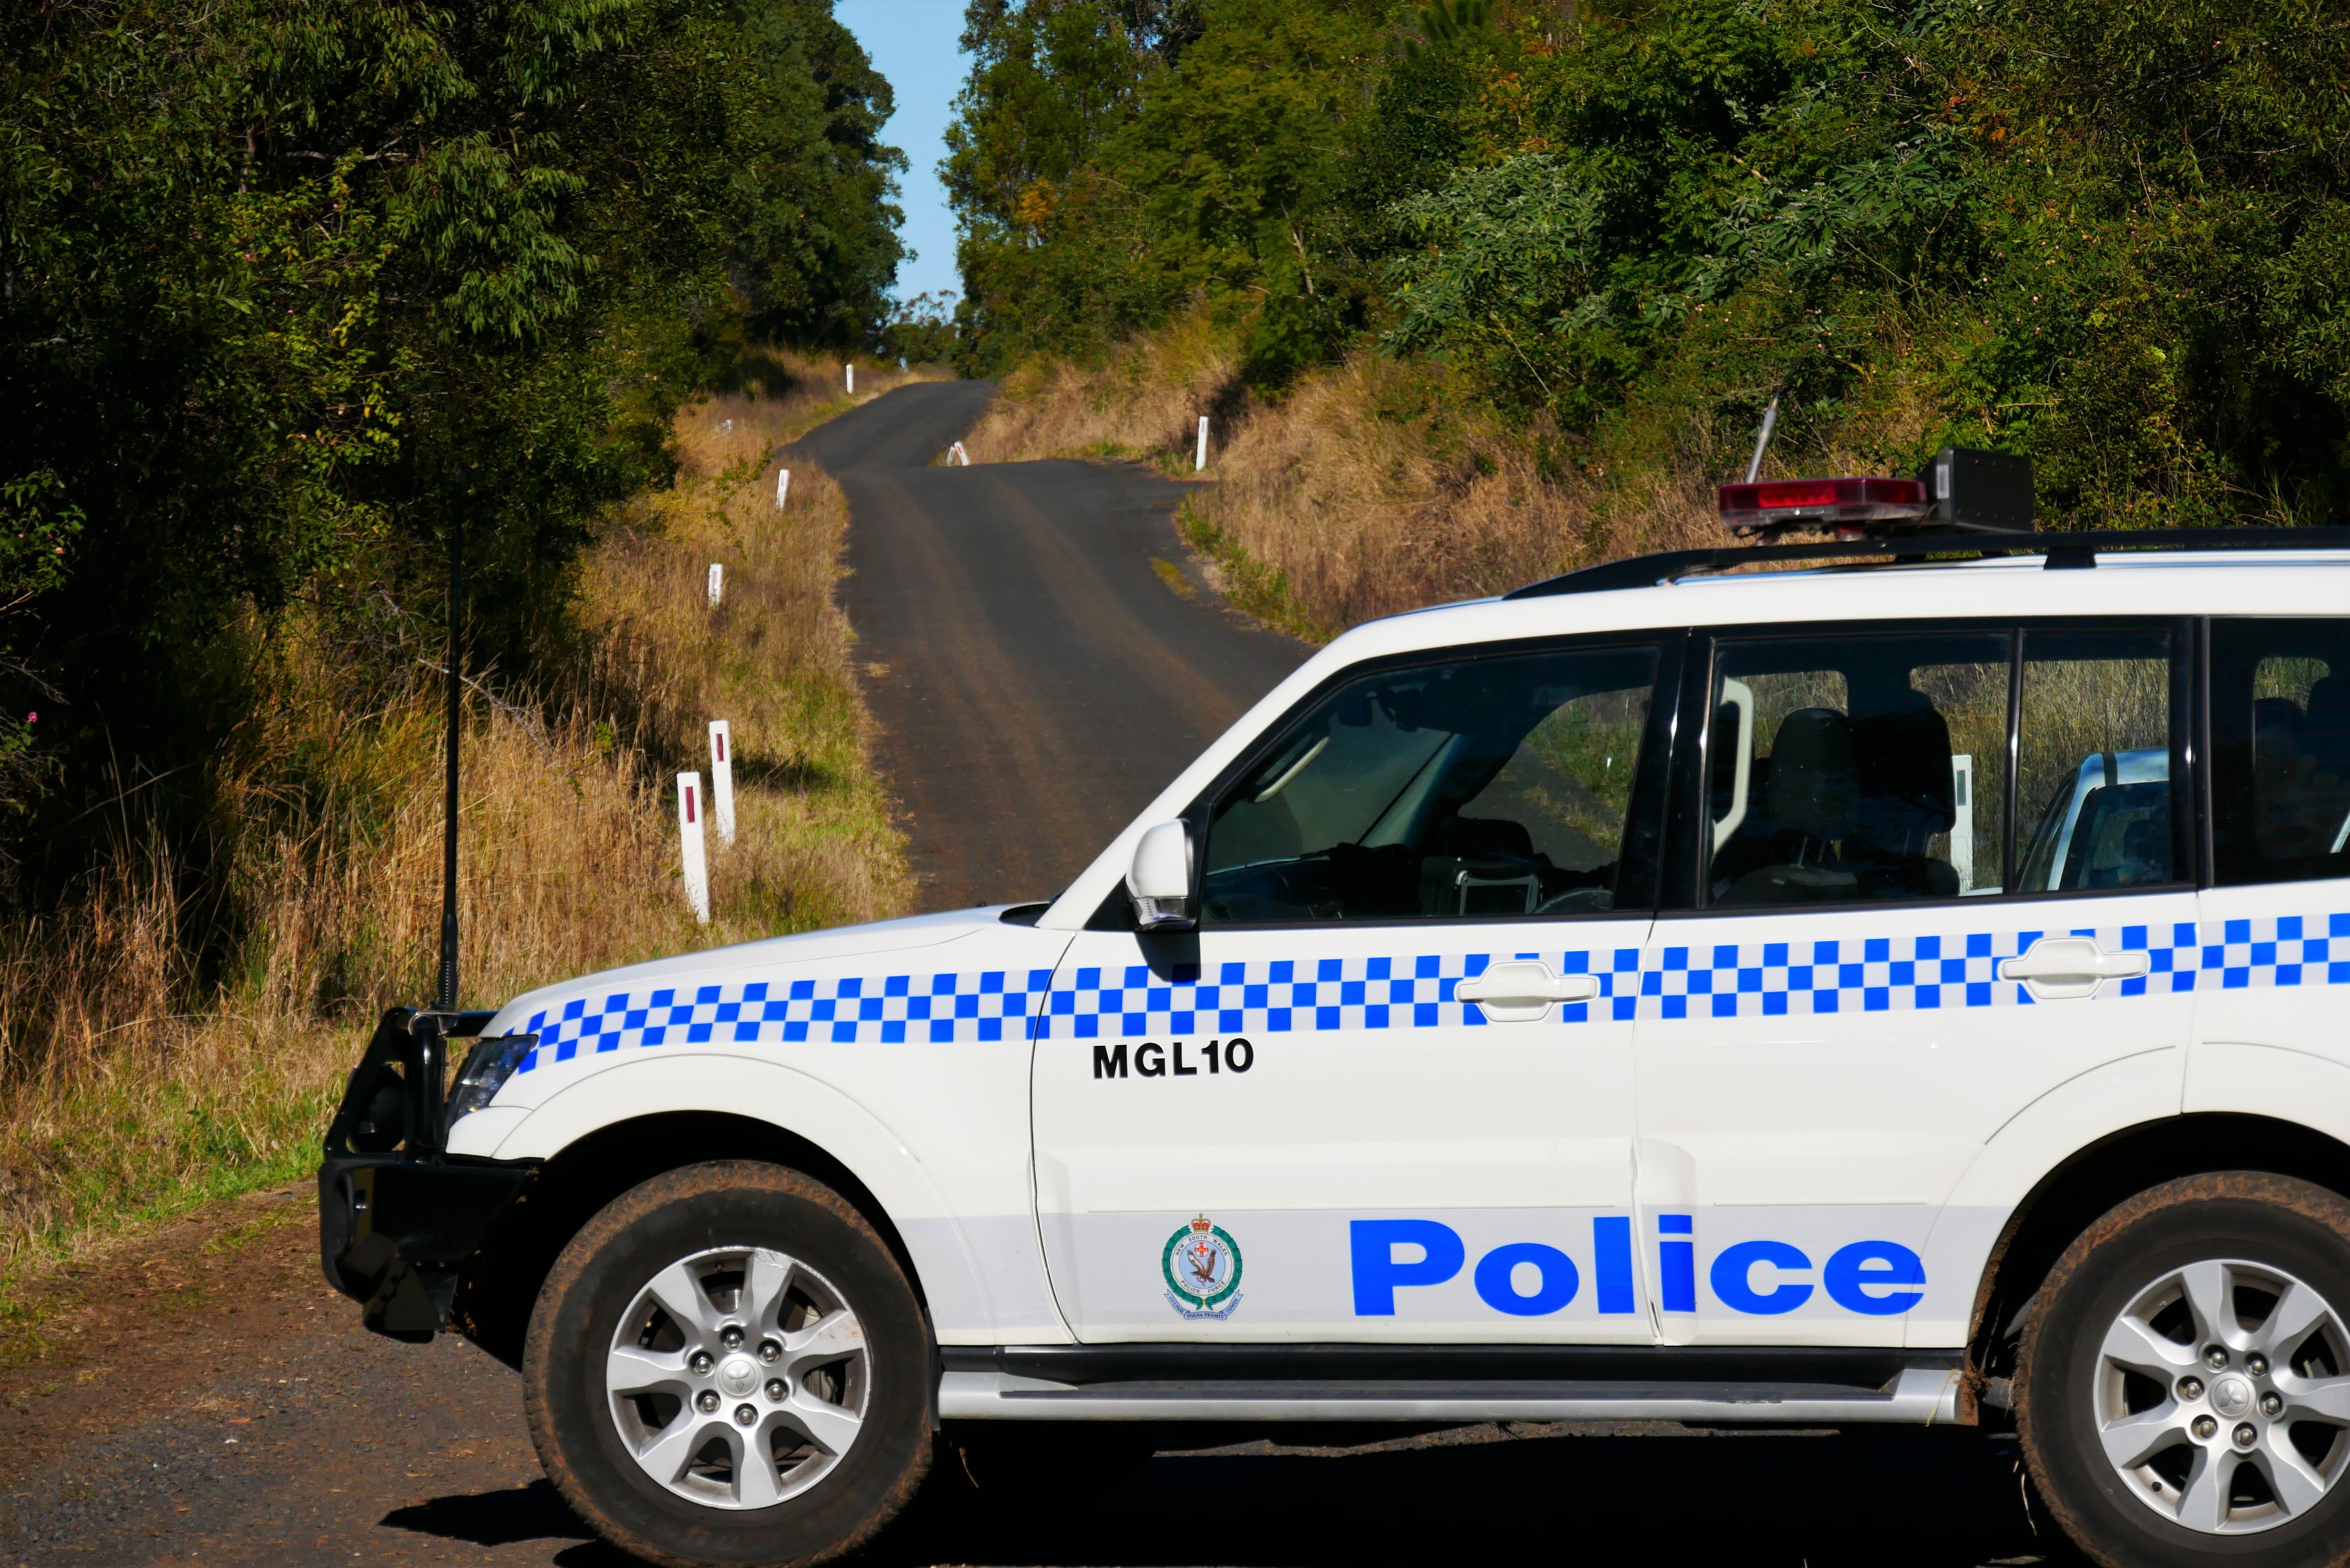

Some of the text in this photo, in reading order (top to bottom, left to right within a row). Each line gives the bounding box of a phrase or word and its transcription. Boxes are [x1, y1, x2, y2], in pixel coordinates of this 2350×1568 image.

[1093, 1038, 1254, 1079] MGL10
[1175, 1243, 1184, 1255] NEW
[1213, 1238, 1228, 1256] WALES
[1350, 1214, 1926, 1316] Police
[1180, 1280, 1225, 1294] POLICE FORCE
[1169, 1296, 1184, 1314] CULPAM
[1226, 1298, 1238, 1313] COMES
